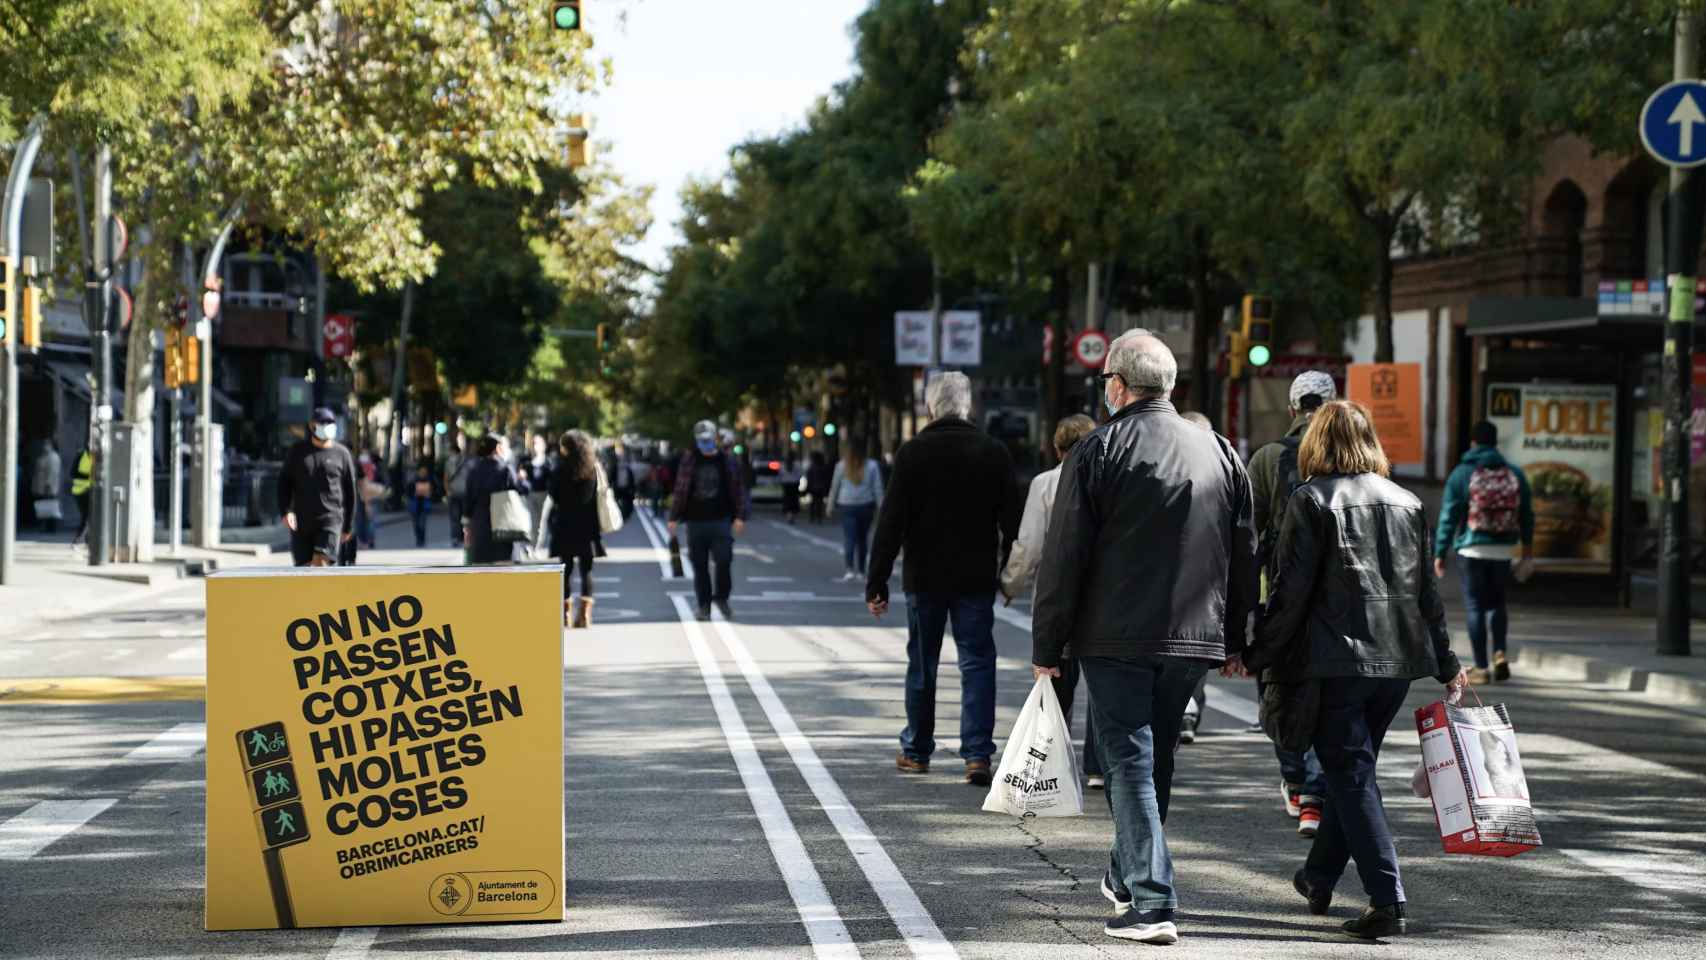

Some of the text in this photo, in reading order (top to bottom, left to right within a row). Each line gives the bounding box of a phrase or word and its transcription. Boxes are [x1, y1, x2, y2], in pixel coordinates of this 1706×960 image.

[1082, 341, 1102, 354] 30
[1524, 399, 1615, 434] DOBLE
[1523, 437, 1610, 451] McPollastre
[286, 594, 423, 652] ON NO
[292, 623, 457, 692] PASSEN
[301, 659, 483, 726] COTXES,
[308, 684, 524, 764] HI PASSEN
[317, 733, 487, 801] MOLTES
[325, 775, 469, 836] COSES
[336, 815, 485, 866] BARCELONA.CAT/
[339, 835, 479, 880] OBRIMCARRERS
[478, 881, 538, 891] Ajuntament de
[478, 891, 538, 902] Barcelona
